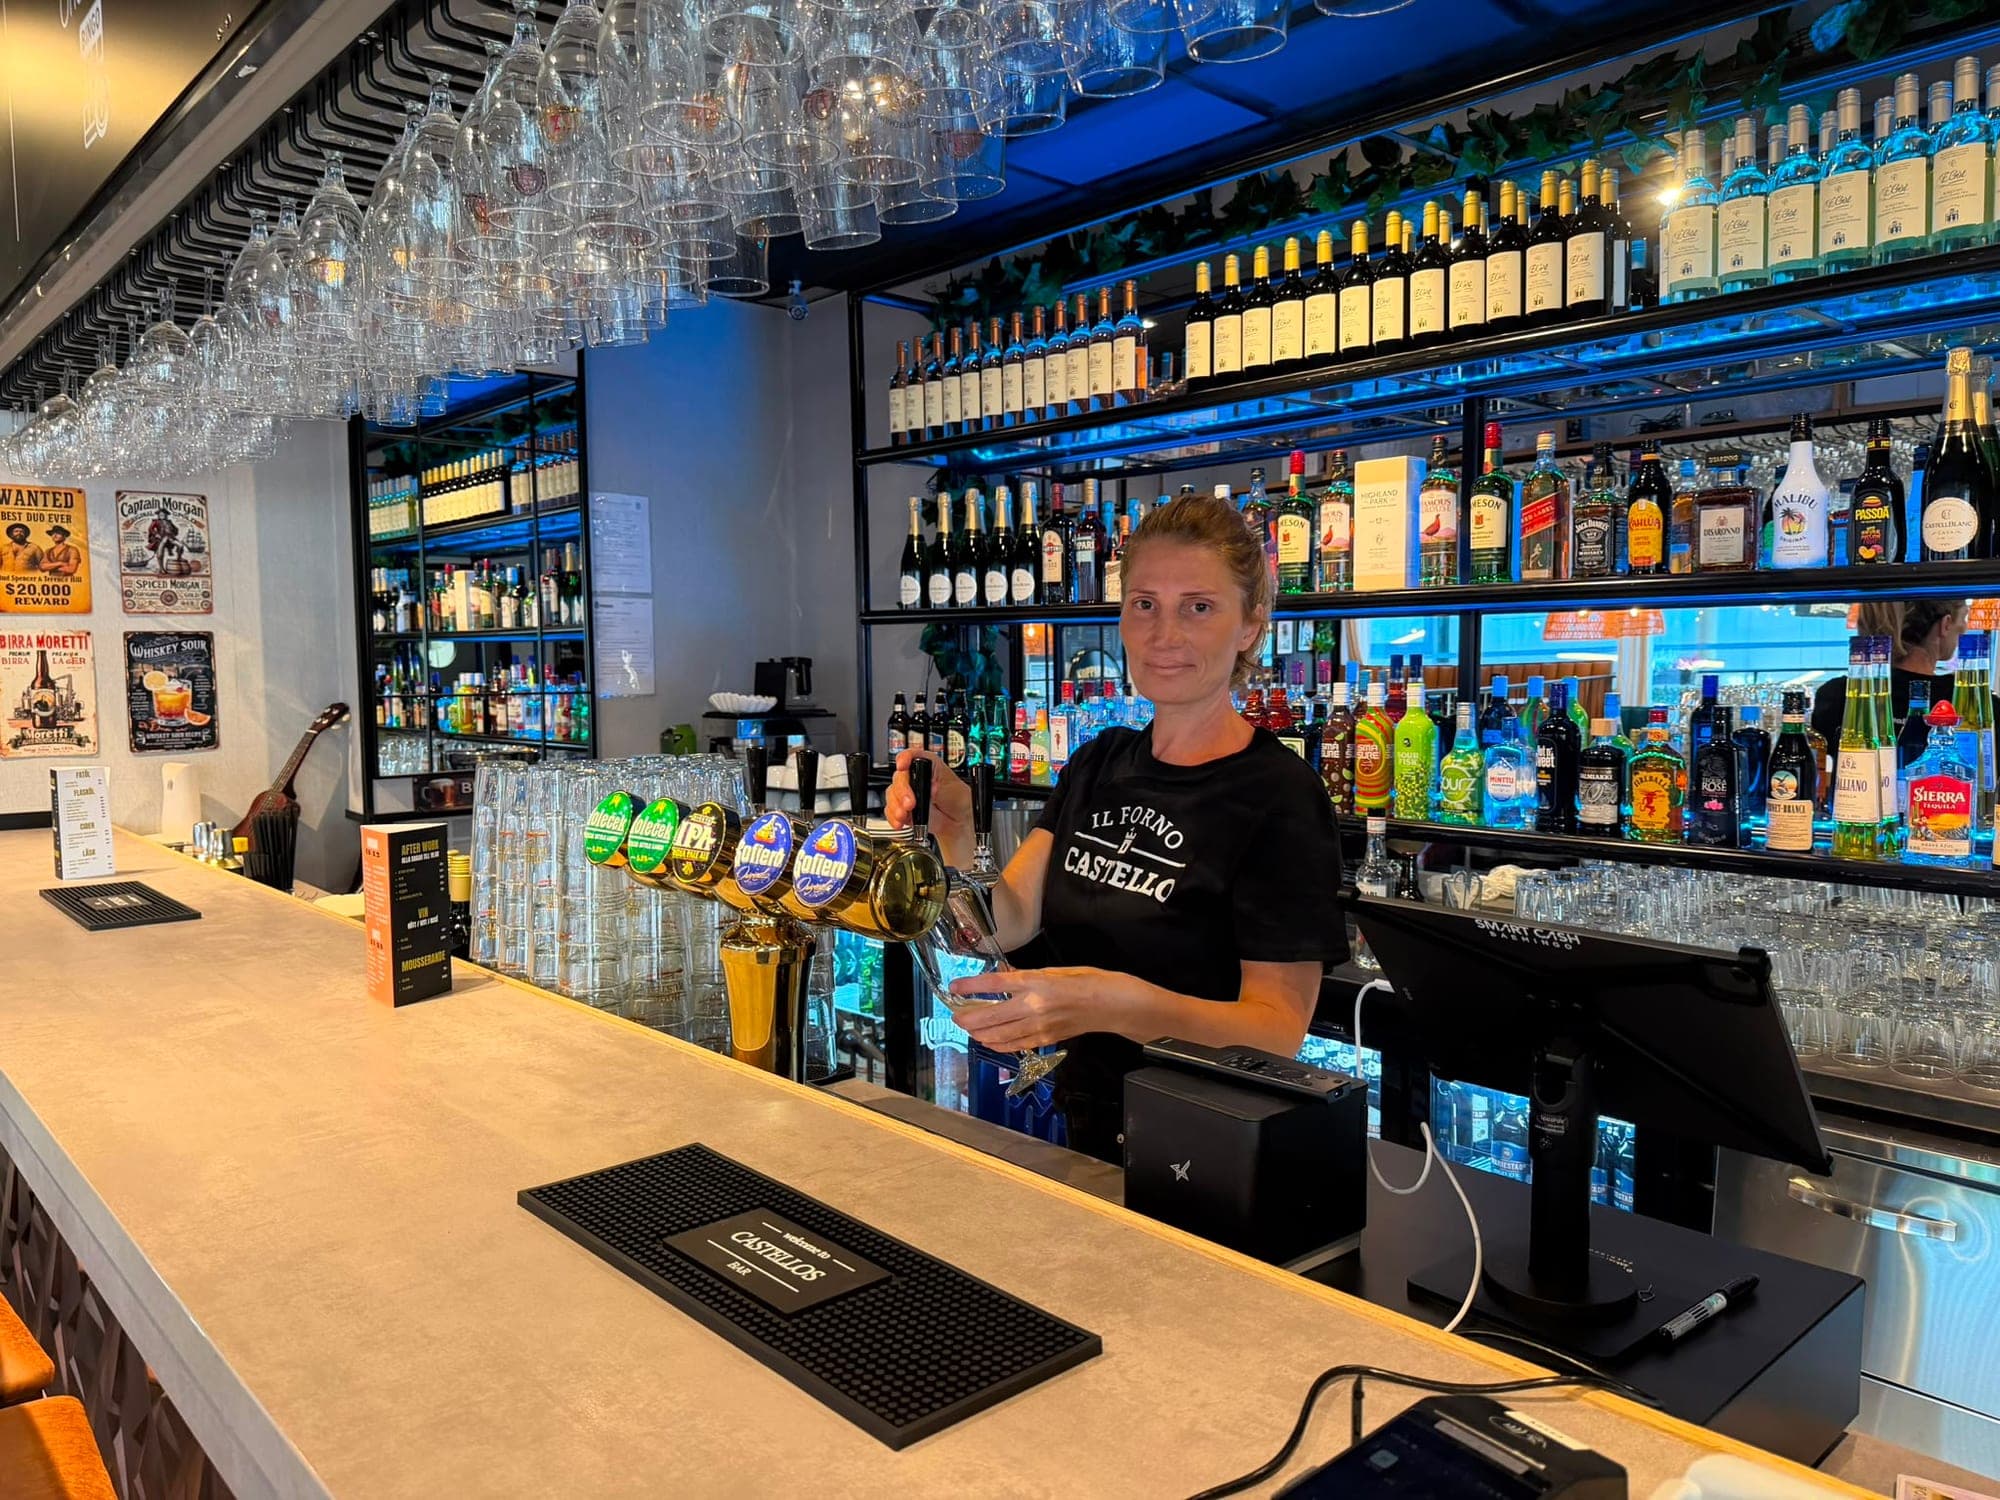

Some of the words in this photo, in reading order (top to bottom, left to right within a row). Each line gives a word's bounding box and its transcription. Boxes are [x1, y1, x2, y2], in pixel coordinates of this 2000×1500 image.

[0, 489, 74, 508] WANTED
[1361, 489, 1398, 498] HIGHLAND
[121, 497, 161, 517] Captain
[162, 497, 204, 519] Morgan
[1424, 498, 1451, 506] AMOUS
[1, 512, 22, 521] BEST
[26, 513, 45, 522] DUO
[48, 515, 72, 523] EVER
[1704, 527, 1741, 537] DISARONNO
[1077, 541, 1095, 550] PARI
[5, 584, 71, 596] $20,000
[136, 580, 168, 589] SPICED
[170, 580, 200, 590] MORGAN
[14, 598, 70, 606] REWARD
[0, 635, 33, 648] BIRRA
[36, 635, 88, 650] MORETTI
[130, 643, 179, 658] WHISKEY
[181, 640, 209, 656] SOUR
[1701, 783, 1727, 792] ROSE
[1913, 786, 1966, 803] SIERRA
[673, 820, 716, 851] IPA
[1091, 811, 1114, 829] IL
[1119, 806, 1184, 849] FORNO
[401, 843, 421, 856] AFTER
[794, 849, 848, 880] Sofiero
[1064, 846, 1176, 903] CASTELLO
[1475, 919, 1528, 935] SMART
[1533, 928, 1581, 944] CASH
[401, 950, 446, 972] MOUSSERANDE
[781, 1232, 822, 1255] welcome
[817, 1248, 831, 1260] to
[730, 1231, 827, 1281] CASTELLOS
[726, 1261, 752, 1276] BAR
